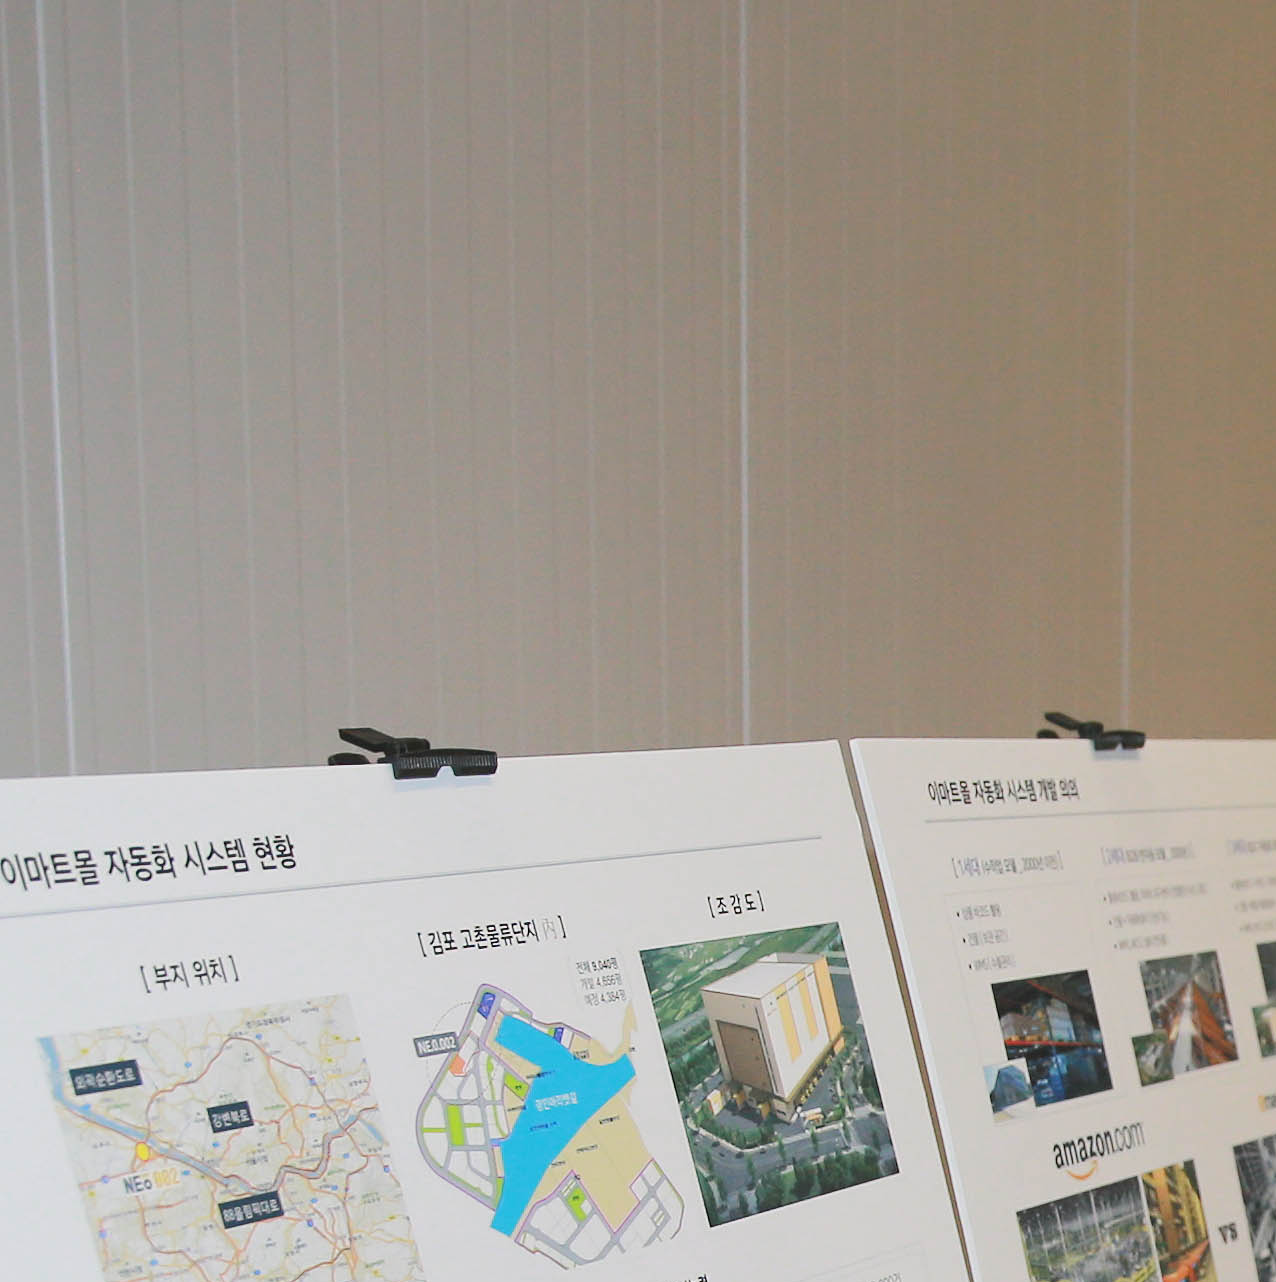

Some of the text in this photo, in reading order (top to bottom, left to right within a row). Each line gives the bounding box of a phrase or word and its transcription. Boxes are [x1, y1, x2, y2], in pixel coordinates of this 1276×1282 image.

[927, 780, 972, 806] 이마트몰
[972, 778, 1006, 805] 자동화
[1006, 778, 1037, 803] 시스템
[1037, 777, 1058, 802] 개발
[0, 833, 297, 891] 이마트몰 자동화 시스템 현황
[428, 930, 458, 956] 김포
[460, 919, 540, 950] 고촌물류단지
[153, 961, 190, 990] 부지
[192, 957, 228, 985] 위치
[1053, 1121, 1145, 1169] amazon.com
